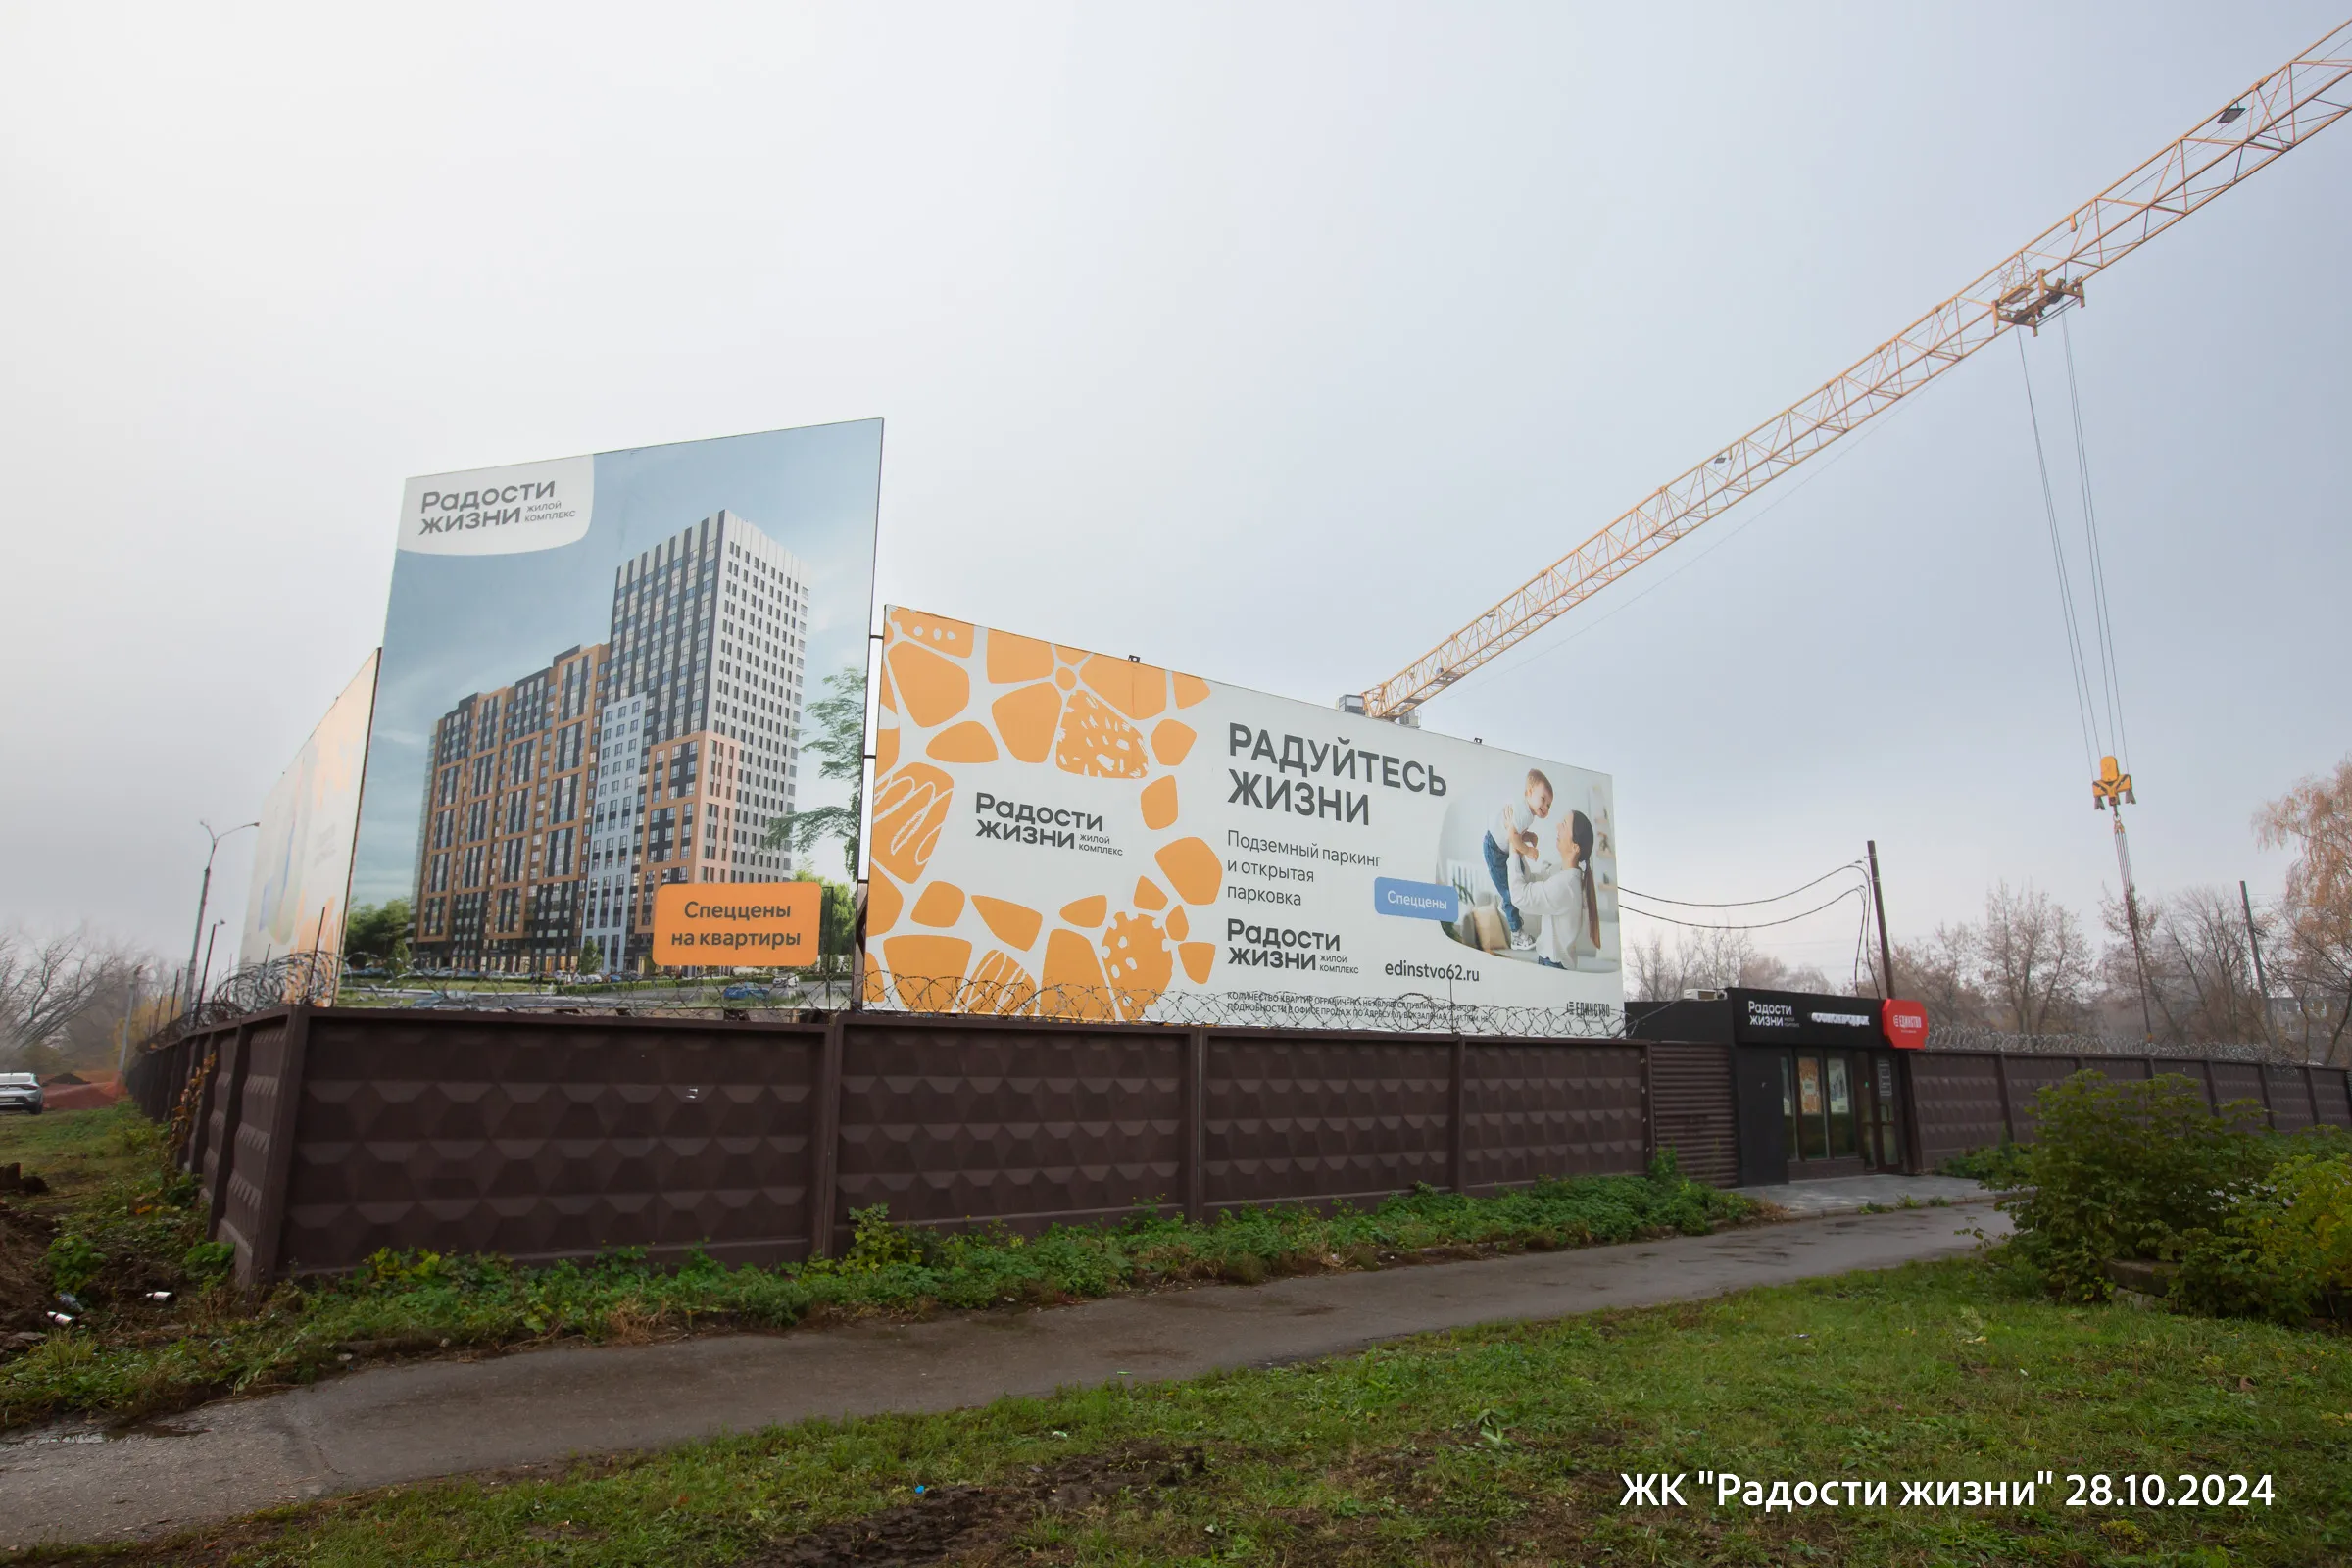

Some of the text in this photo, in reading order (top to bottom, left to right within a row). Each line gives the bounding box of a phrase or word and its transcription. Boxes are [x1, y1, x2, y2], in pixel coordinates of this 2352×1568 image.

[420, 480, 556, 514] Радости
[524, 510, 576, 522] КОМПЛЕКС
[1229, 722, 1447, 797] РАДУЙТЕСЬ
[1227, 768, 1369, 826] ЖИЗНИ
[975, 791, 1103, 832] Радости
[1078, 843, 1123, 857] КОМПЛЕКС
[1227, 829, 1382, 868] Подземный паркинг
[1227, 859, 1314, 883] и открытая
[1227, 885, 1301, 906] парковка
[1387, 890, 1447, 910] Спеццены
[684, 901, 791, 921] Спеццены
[671, 933, 801, 950] на квартиры
[1227, 918, 1341, 952] Радости
[1384, 960, 1480, 982] edinstvo62.ru
[1747, 1000, 1792, 1015] Радости
